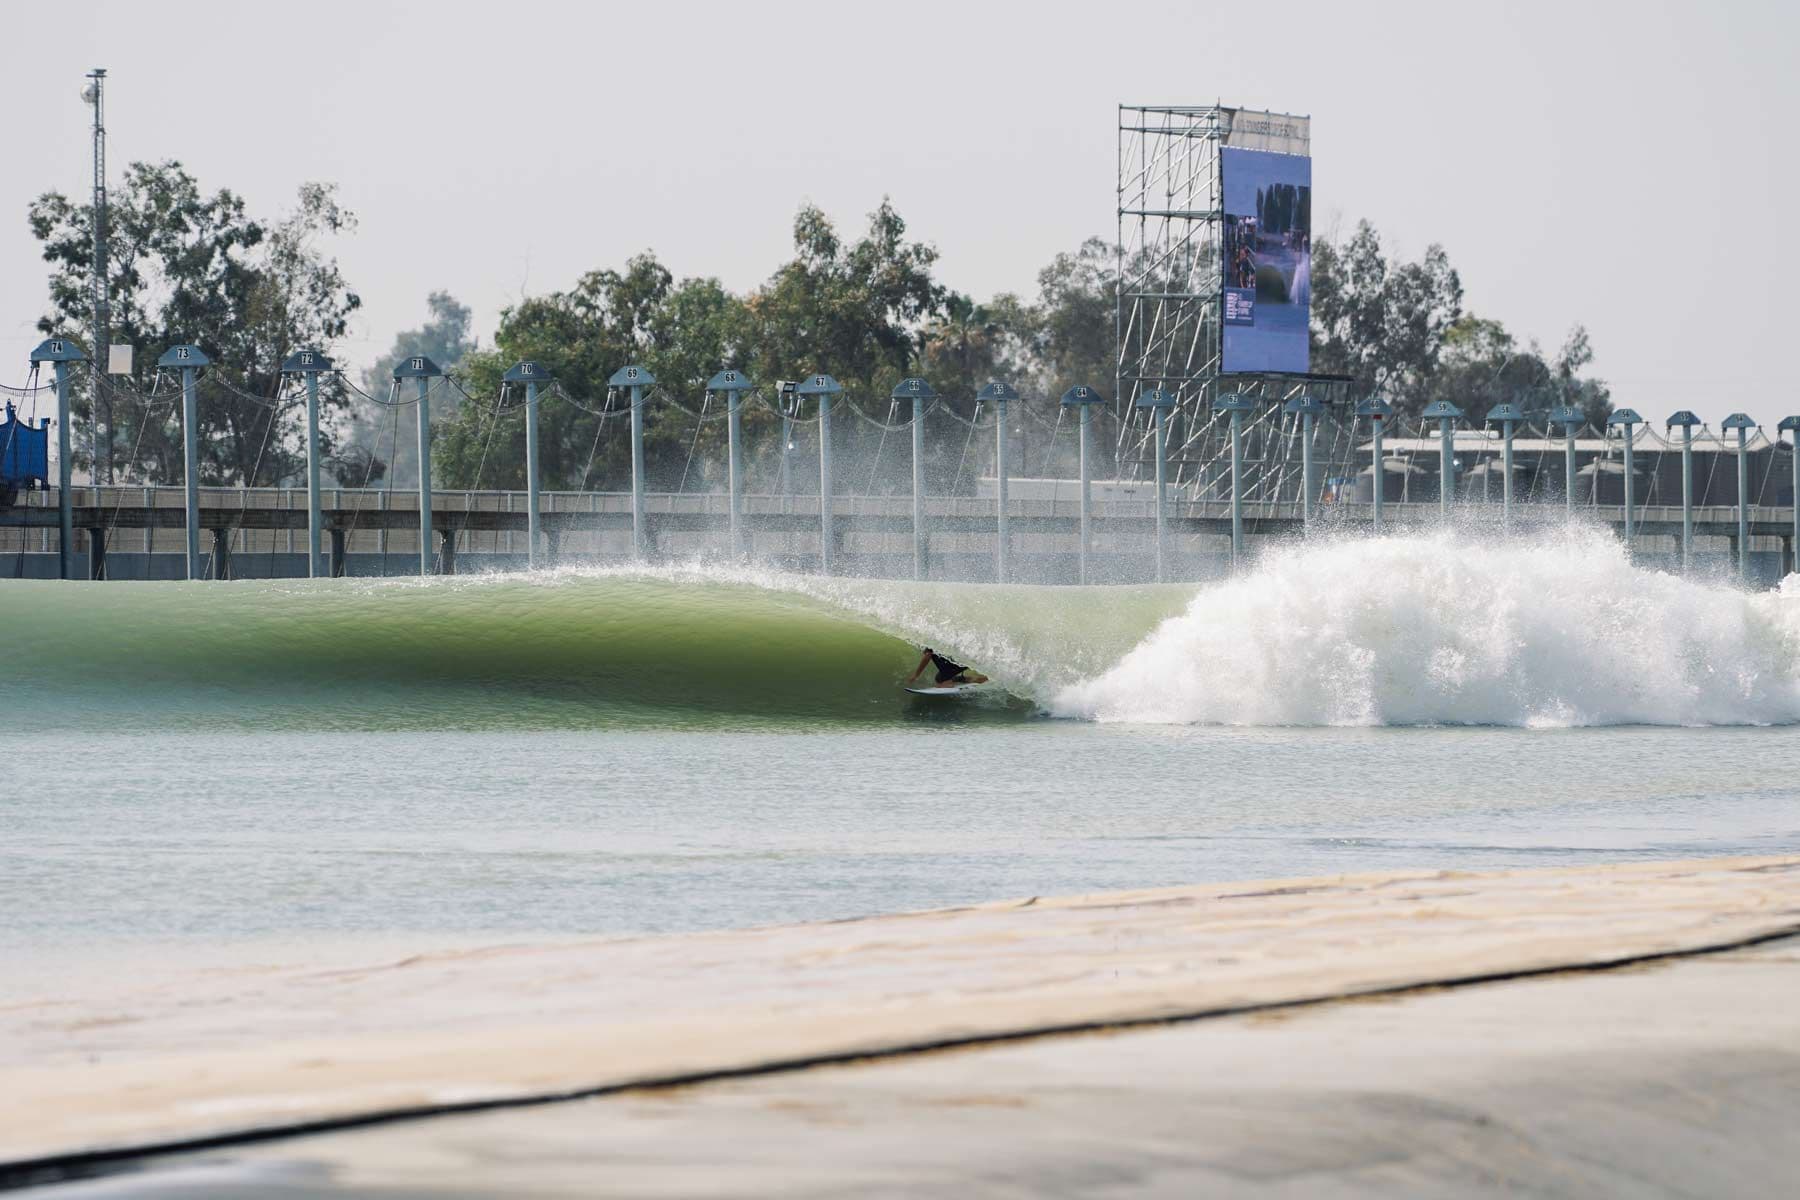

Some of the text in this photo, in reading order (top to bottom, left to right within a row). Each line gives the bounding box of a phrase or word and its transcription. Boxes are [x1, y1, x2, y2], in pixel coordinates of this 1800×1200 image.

[52, 342, 62, 353] 74
[178, 348, 188, 358] 73
[302, 353, 312, 363] 72
[412, 359, 422, 369] 71
[522, 364, 532, 374] 70
[627, 368, 637, 378] 69
[725, 373, 735, 382] 68
[816, 377, 825, 386] 67
[909, 381, 919, 390] 66
[994, 384, 1003, 393] 65
